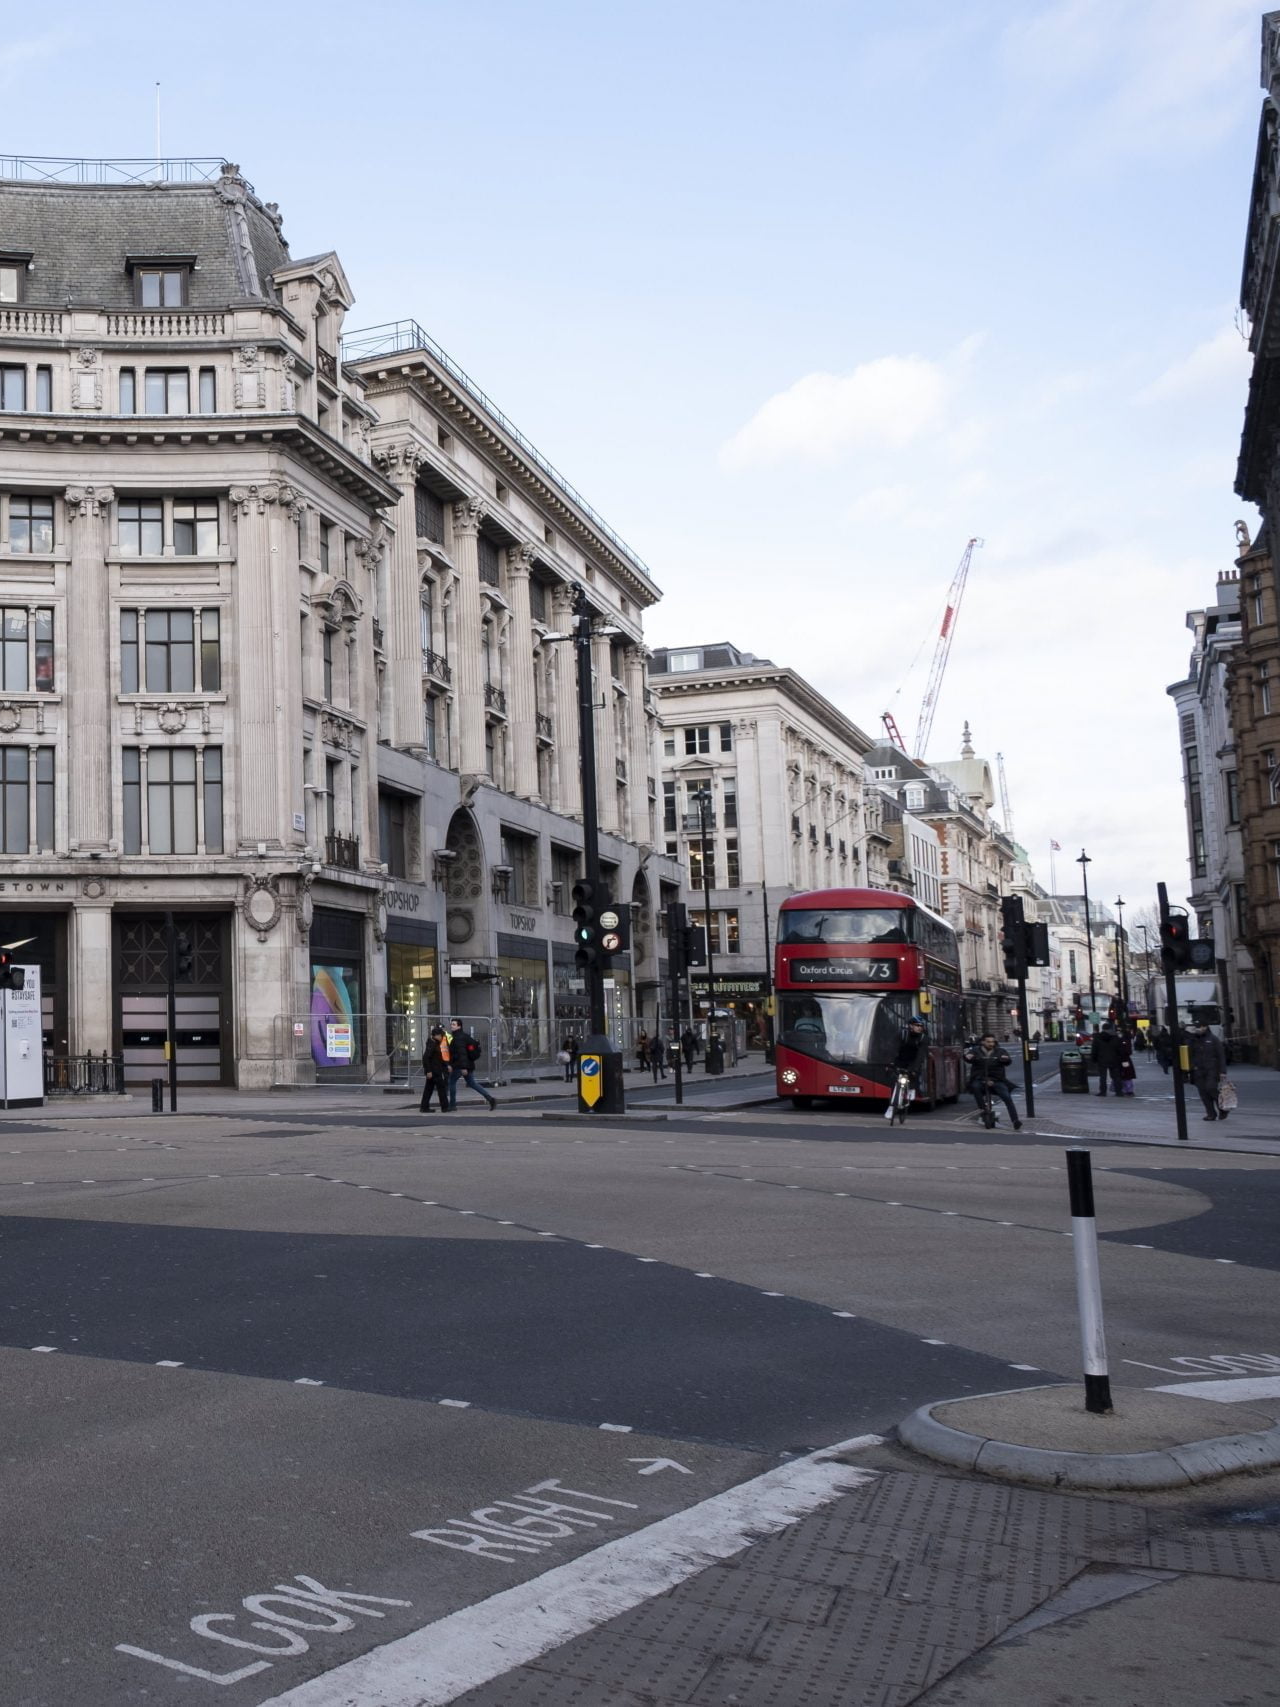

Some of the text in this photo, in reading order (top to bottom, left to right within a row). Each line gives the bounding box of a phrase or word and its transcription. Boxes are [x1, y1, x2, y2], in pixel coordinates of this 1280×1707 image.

[387, 890, 419, 912] OPSHOP
[510, 912, 536, 932] TOPSHOP
[800, 962, 890, 978] Oxford Circus 73
[115, 1478, 638, 1685] LOOK RIGHT
